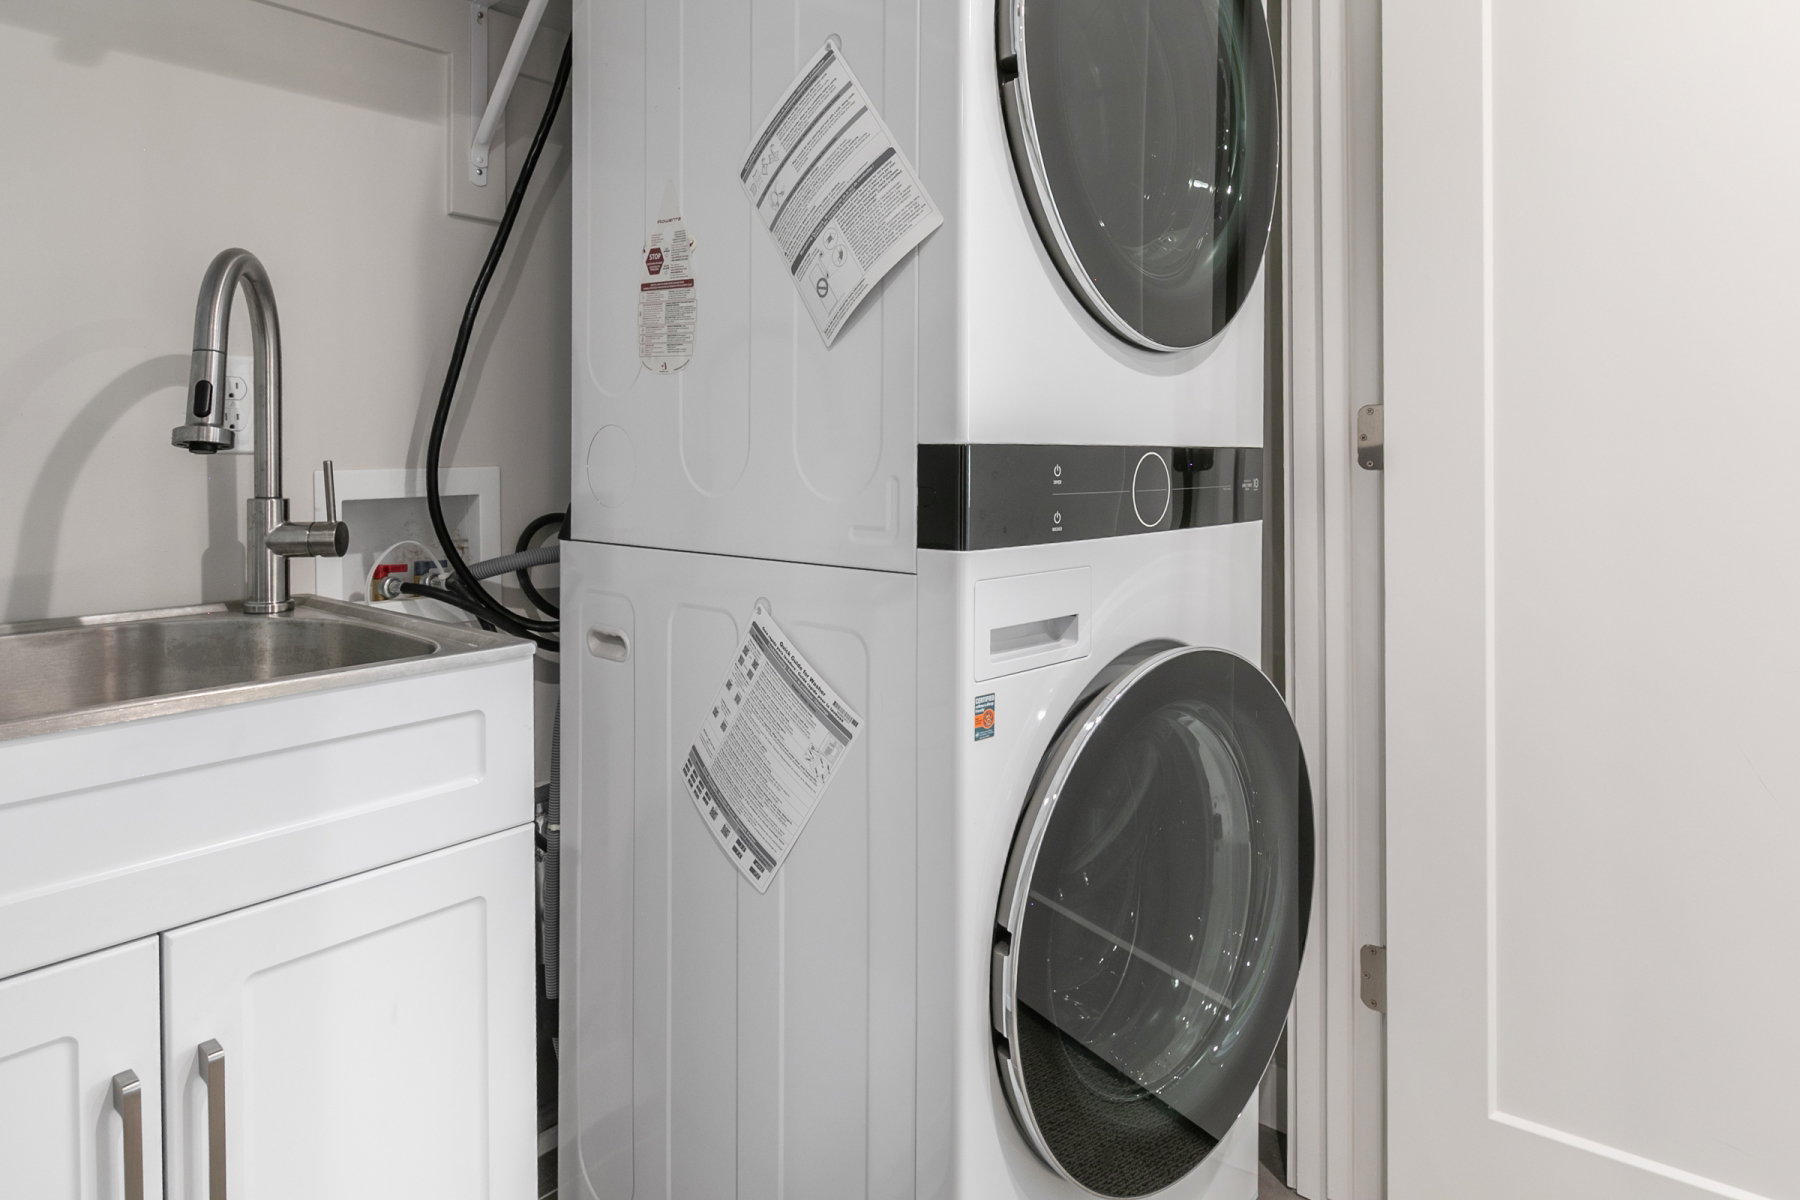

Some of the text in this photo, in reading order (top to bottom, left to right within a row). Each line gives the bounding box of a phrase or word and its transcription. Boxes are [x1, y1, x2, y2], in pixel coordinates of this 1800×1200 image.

[780, 641, 791, 658] Quick
[790, 655, 803, 671] Guide
[809, 677, 826, 697] Washer
